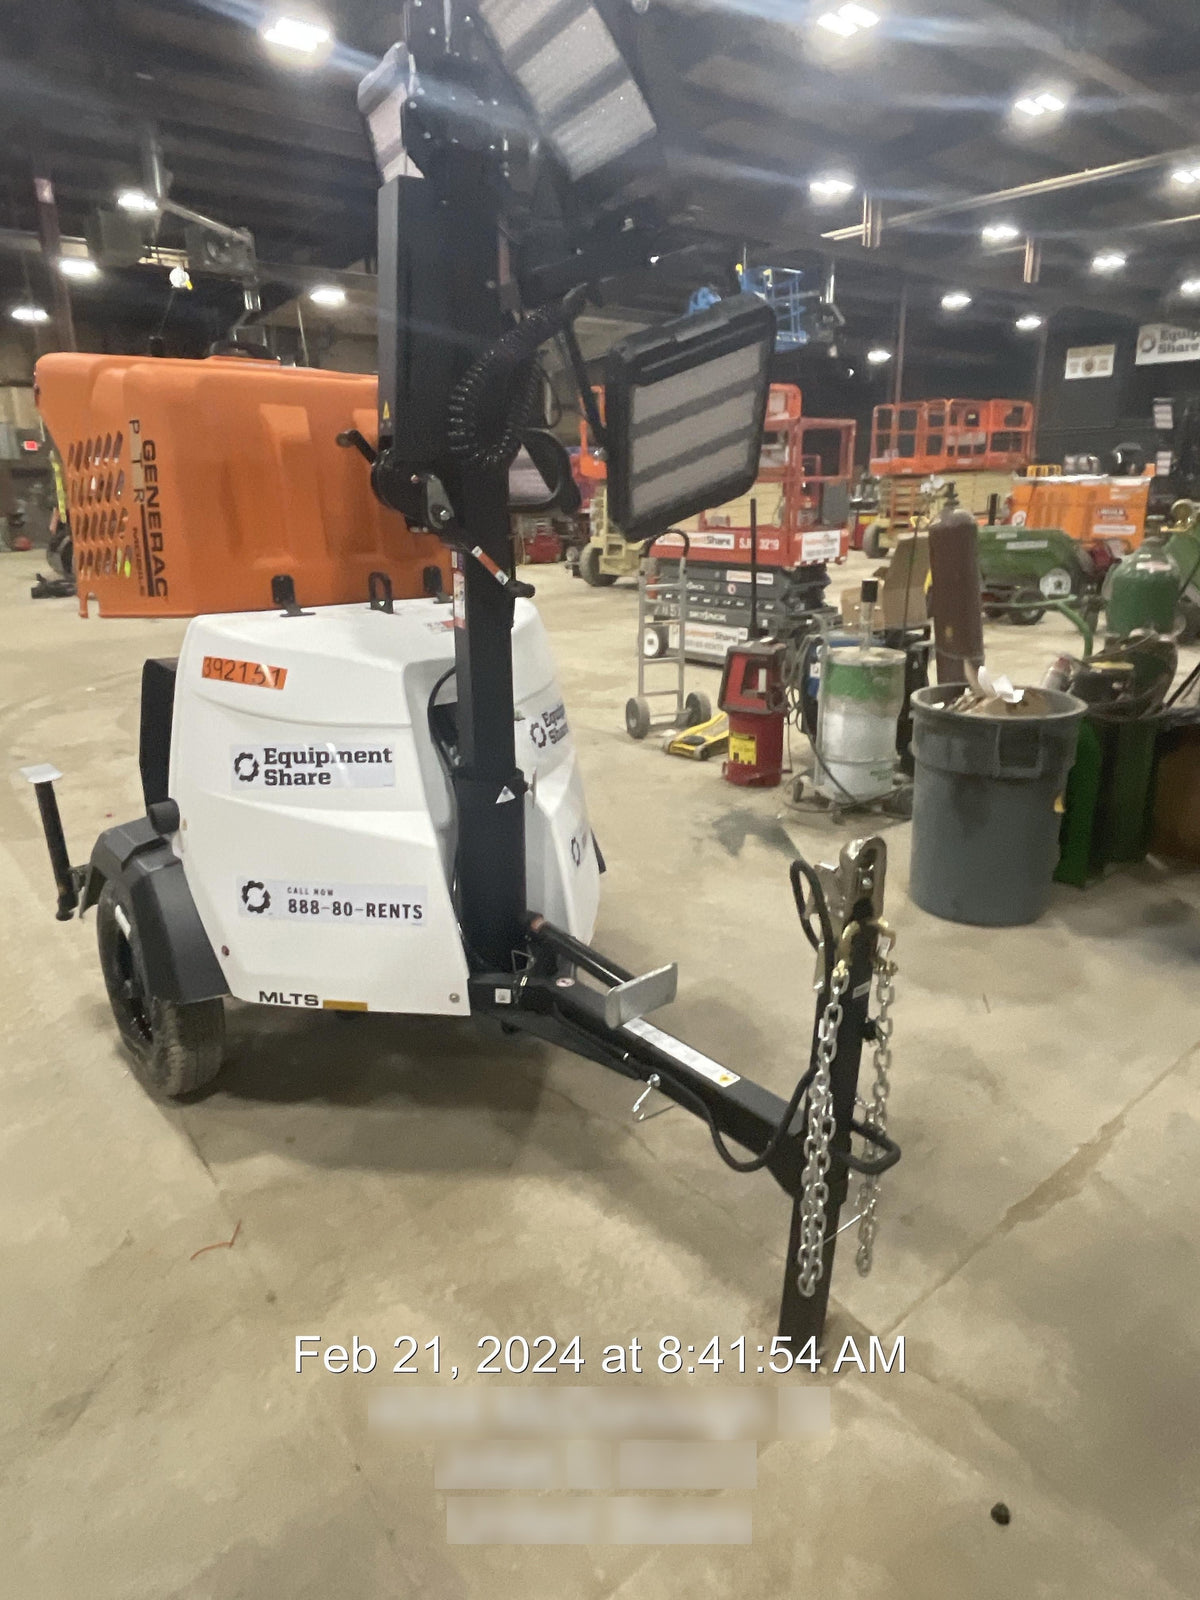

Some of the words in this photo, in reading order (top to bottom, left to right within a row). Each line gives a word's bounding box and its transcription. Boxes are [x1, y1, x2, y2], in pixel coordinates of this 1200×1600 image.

[142, 439, 168, 597] GENERAC
[263, 747, 393, 769] Equipment
[263, 769, 332, 786] Share
[287, 886, 310, 896] CALL
[313, 888, 334, 897] NOW
[288, 898, 423, 920] 888-80-RENTS
[259, 990, 319, 1007] MLTS
